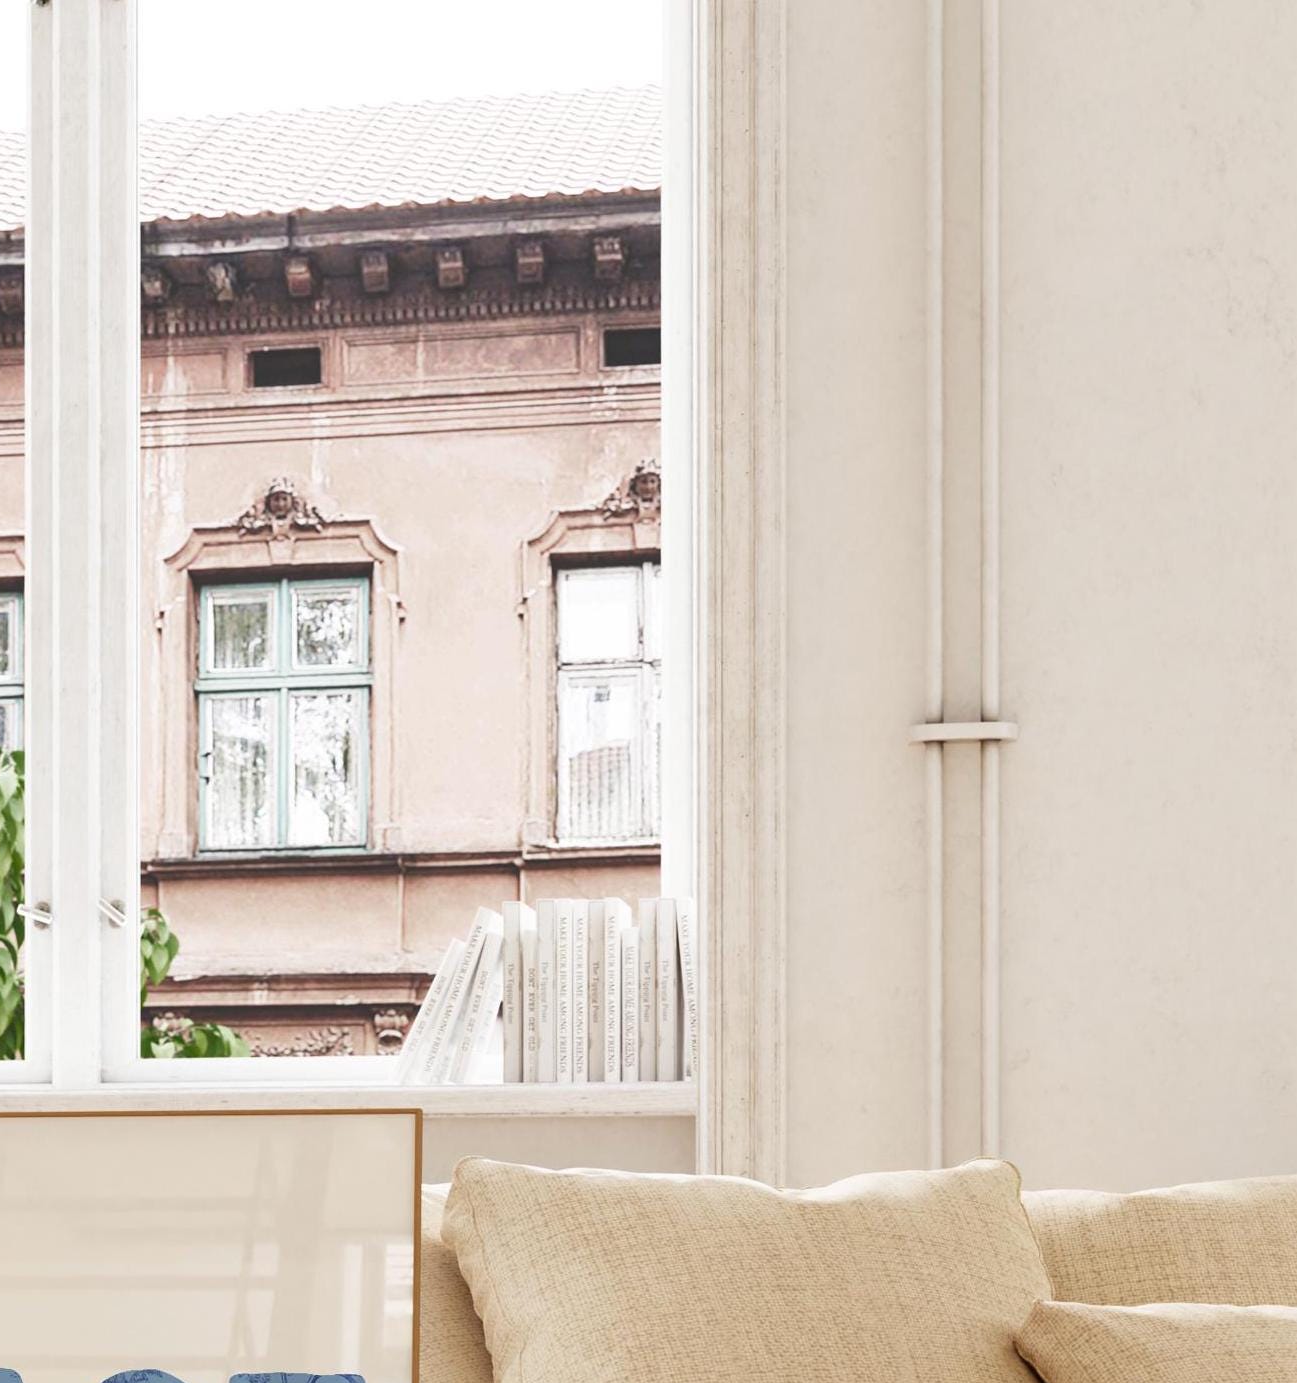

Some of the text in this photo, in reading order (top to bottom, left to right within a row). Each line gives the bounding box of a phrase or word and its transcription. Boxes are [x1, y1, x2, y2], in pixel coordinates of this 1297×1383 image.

[469, 925, 483, 948] MAKE
[460, 950, 474, 974] YOUR
[451, 975, 465, 1001] HOME
[558, 916, 569, 1074] MAKE YOUR HOME AMONG FRIENDS
[575, 917, 584, 1075] MAKE YOUR HOME AMONG FRIENDS
[606, 915, 617, 1073] MAKE YOUR HOME AMONG FRIENDS
[527, 992, 536, 1013] EVER
[440, 1003, 455, 1034] AMONG
[527, 1016, 536, 1032] GET
